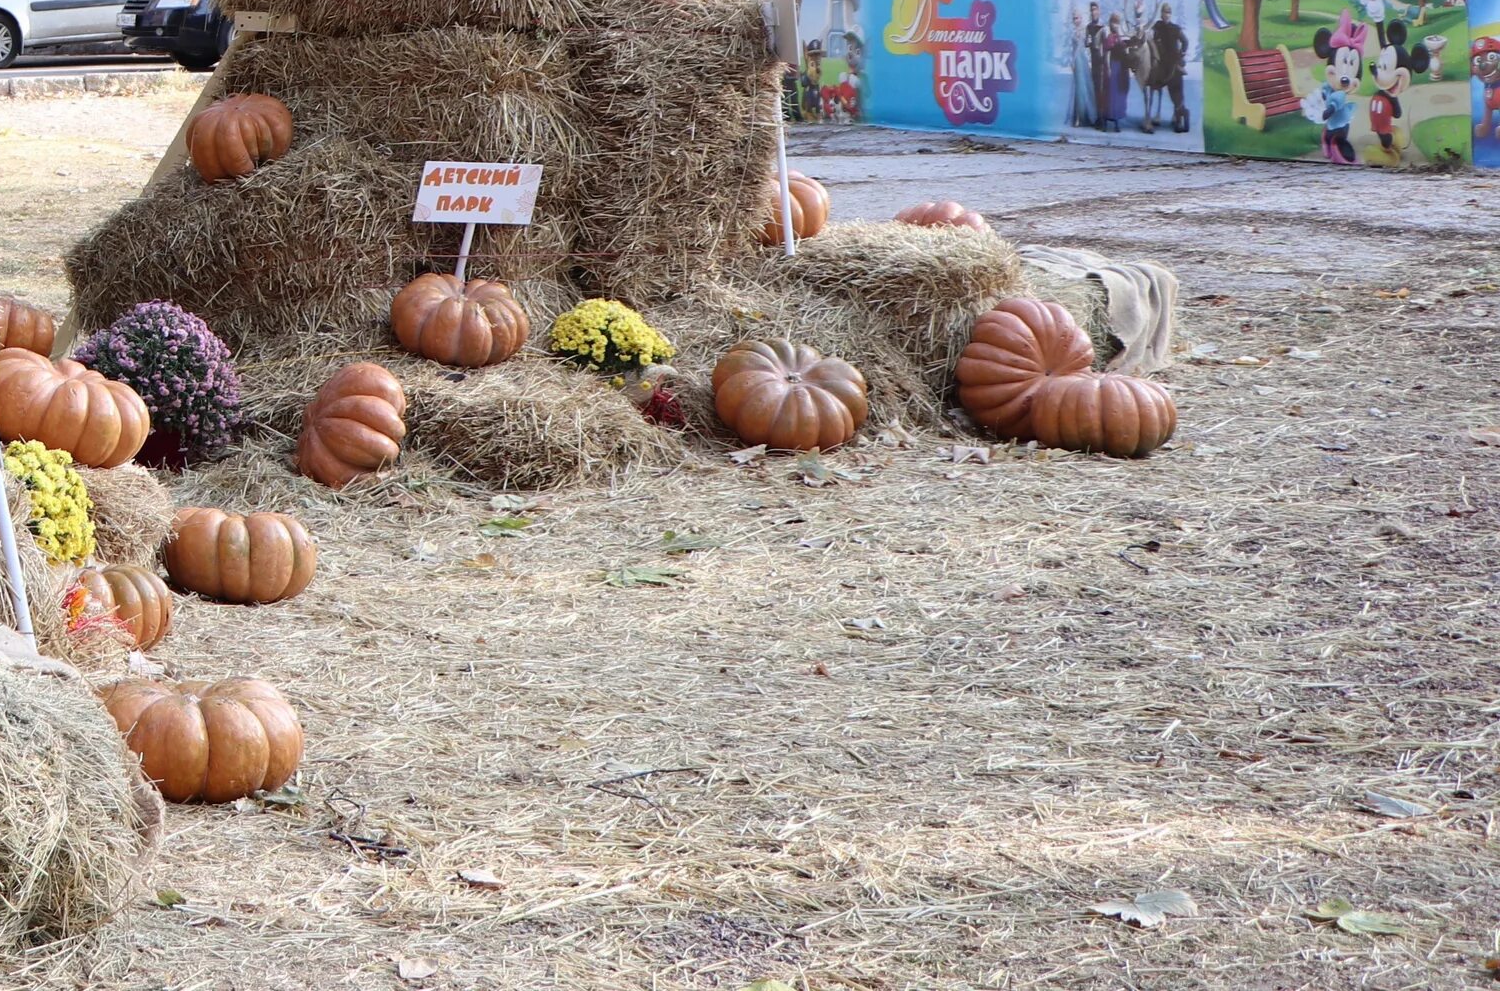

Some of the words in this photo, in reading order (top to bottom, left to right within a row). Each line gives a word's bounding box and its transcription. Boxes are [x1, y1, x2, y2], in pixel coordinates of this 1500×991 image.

[939, 49, 1013, 91] парк
[423, 165, 521, 187] ДЕТСКИЙ
[435, 195, 493, 213] ПАРК
